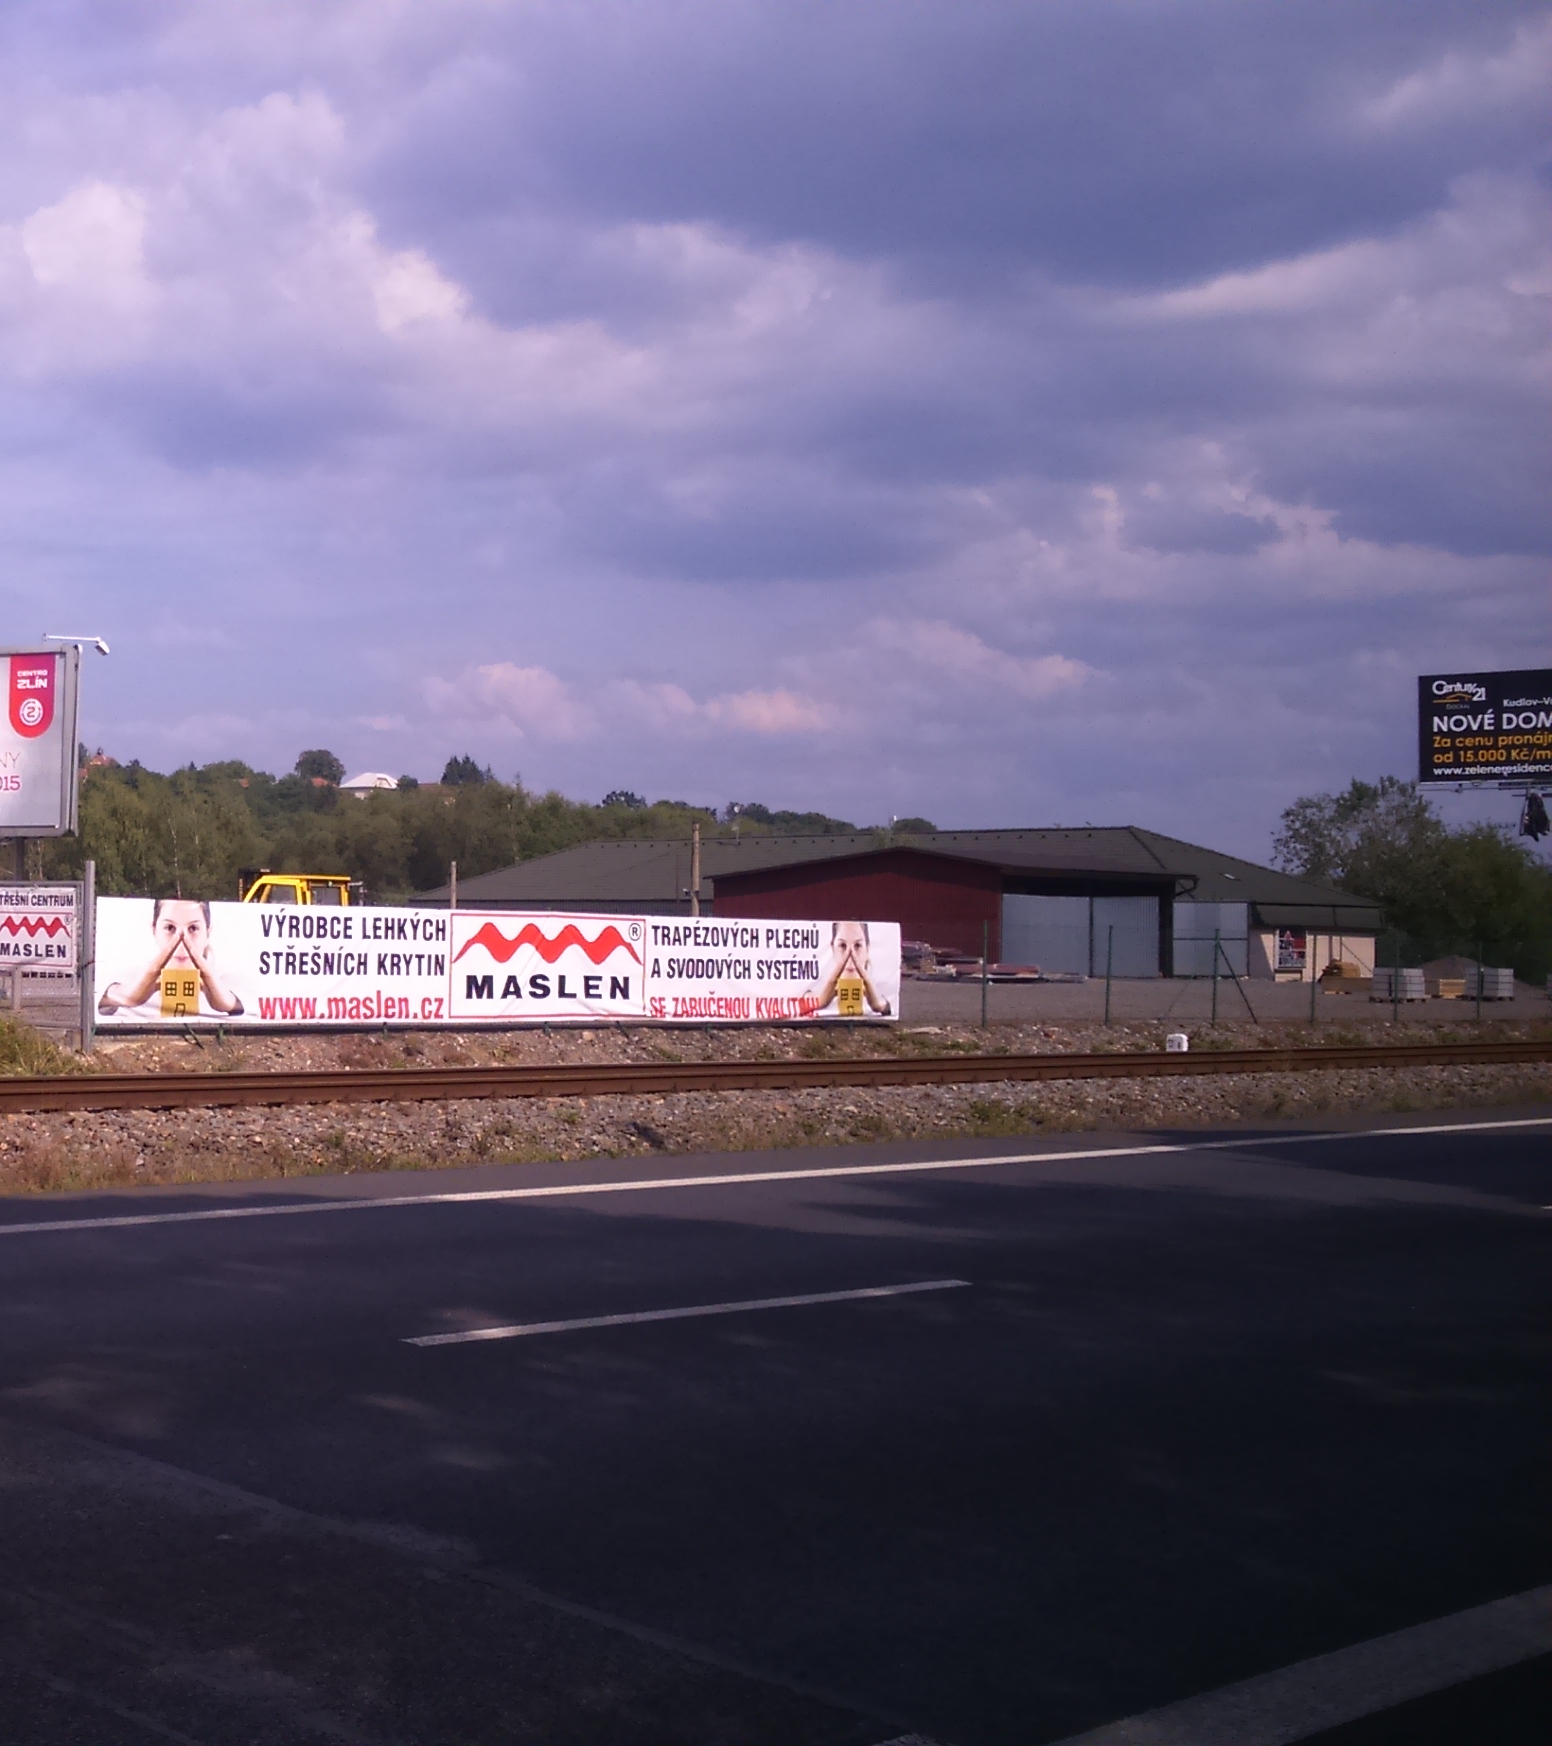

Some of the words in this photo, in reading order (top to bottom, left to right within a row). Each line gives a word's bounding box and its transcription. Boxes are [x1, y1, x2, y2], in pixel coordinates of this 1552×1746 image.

[1432, 708, 1495, 732] NOVÉ
[1433, 736, 1451, 747] Za
[1455, 736, 1493, 747] cenu
[1433, 751, 1453, 763] od
[1459, 749, 1507, 762] 15.000
[31, 895, 74, 907] CENTRUM
[261, 908, 353, 940] VÝROBCE
[362, 912, 446, 942] LEHKÝCH
[651, 920, 759, 948] TRAPÉZOVÝCH
[766, 923, 819, 950] PLECHŮ
[0, 942, 66, 958] MASLEN
[259, 945, 368, 976] STŘEŠNÍCH
[377, 953, 445, 976] KRYTIN
[651, 957, 661, 979] A
[667, 953, 751, 979] SVODOVÝCH
[756, 954, 819, 980] SYSTÉMŮ
[466, 974, 630, 1000] MASLEN
[259, 991, 444, 1019] www.maslen.cz
[650, 996, 666, 1018] SE
[672, 991, 750, 1019] ZARUČENOU
